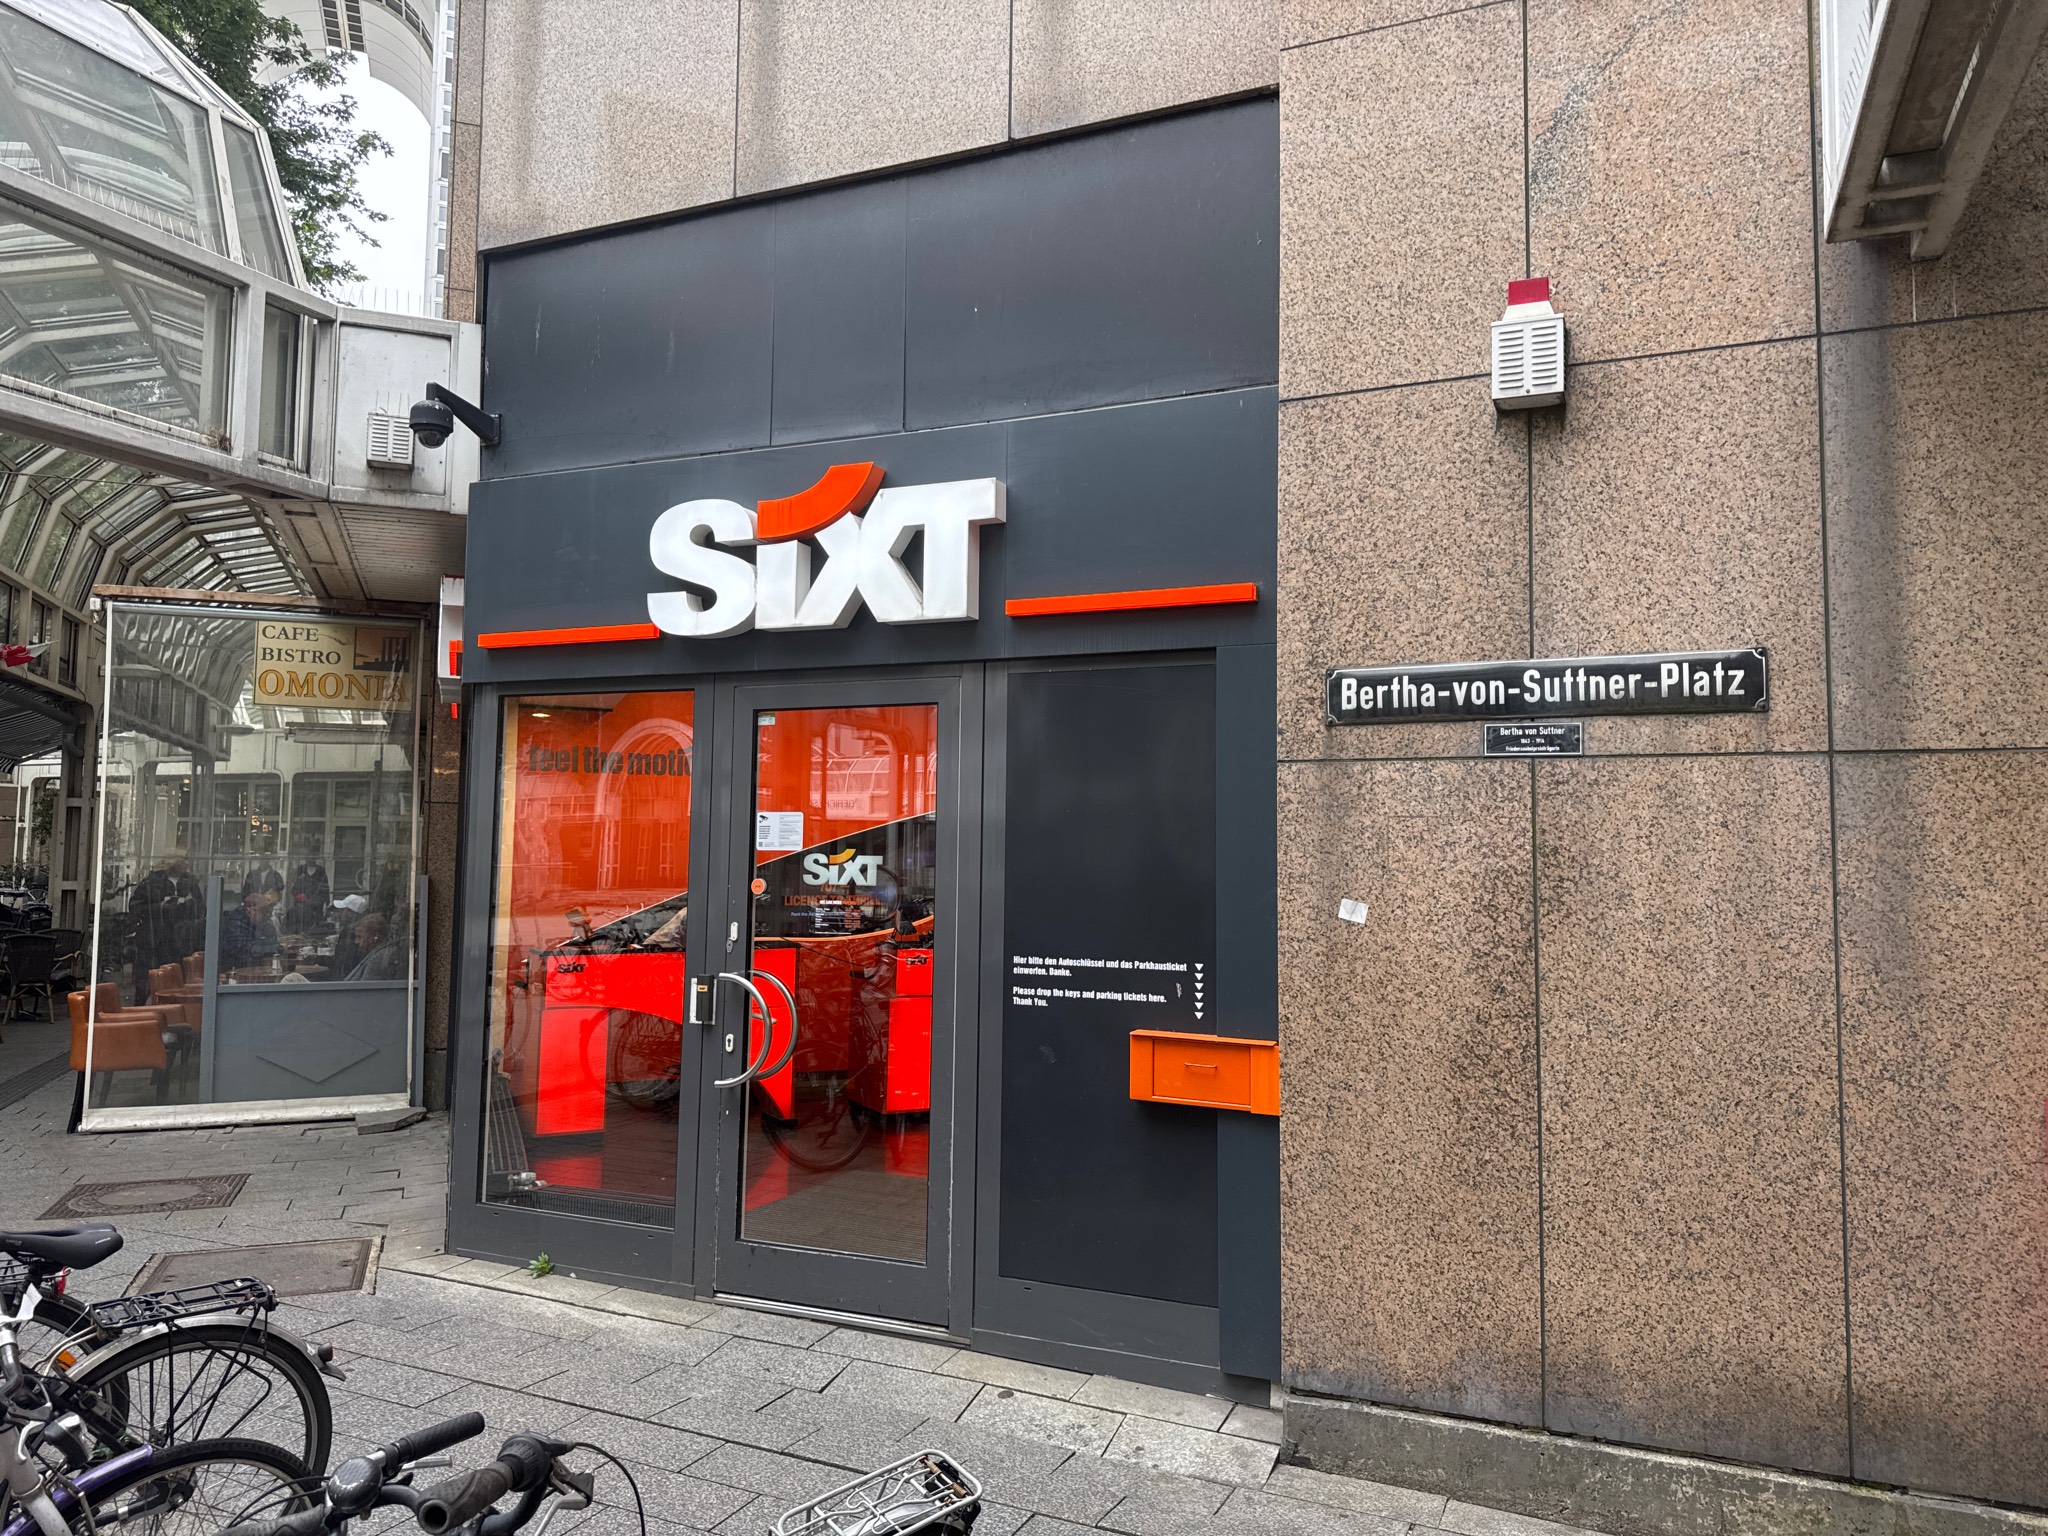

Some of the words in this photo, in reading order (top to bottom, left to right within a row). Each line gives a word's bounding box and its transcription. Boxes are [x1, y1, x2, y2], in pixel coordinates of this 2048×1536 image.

[262, 625, 319, 642] CAFE
[261, 647, 342, 665] BISTRO
[258, 669, 410, 702] OMONIA
[1341, 661, 1746, 711] Bertha-von-Suttner-Platz
[1500, 727, 1523, 736] Bertha
[1539, 727, 1565, 735] Suttner
[529, 744, 579, 773] feel
[583, 746, 624, 774] the
[1013, 955, 1027, 964] Hier
[1028, 956, 1043, 965] bitte
[1044, 957, 1057, 965] den
[1058, 957, 1105, 968] Autoschlüssel
[1106, 959, 1119, 968] und
[1120, 960, 1133, 969] das
[1134, 960, 1187, 972] Parkhausticket
[1013, 966, 1048, 976] einwerfen.
[1049, 967, 1072, 977] Danke.
[1012, 986, 1035, 996] Please
[1036, 987, 1052, 997] drop
[1052, 988, 1064, 997] the
[1064, 989, 1081, 999] keys
[1082, 990, 1095, 999] and
[1096, 991, 1122, 1001] parking
[1123, 992, 1147, 1002] tickets
[1148, 993, 1167, 1003] here.
[1012, 996, 1033, 1006] Thank
[1034, 997, 1048, 1007] You.
